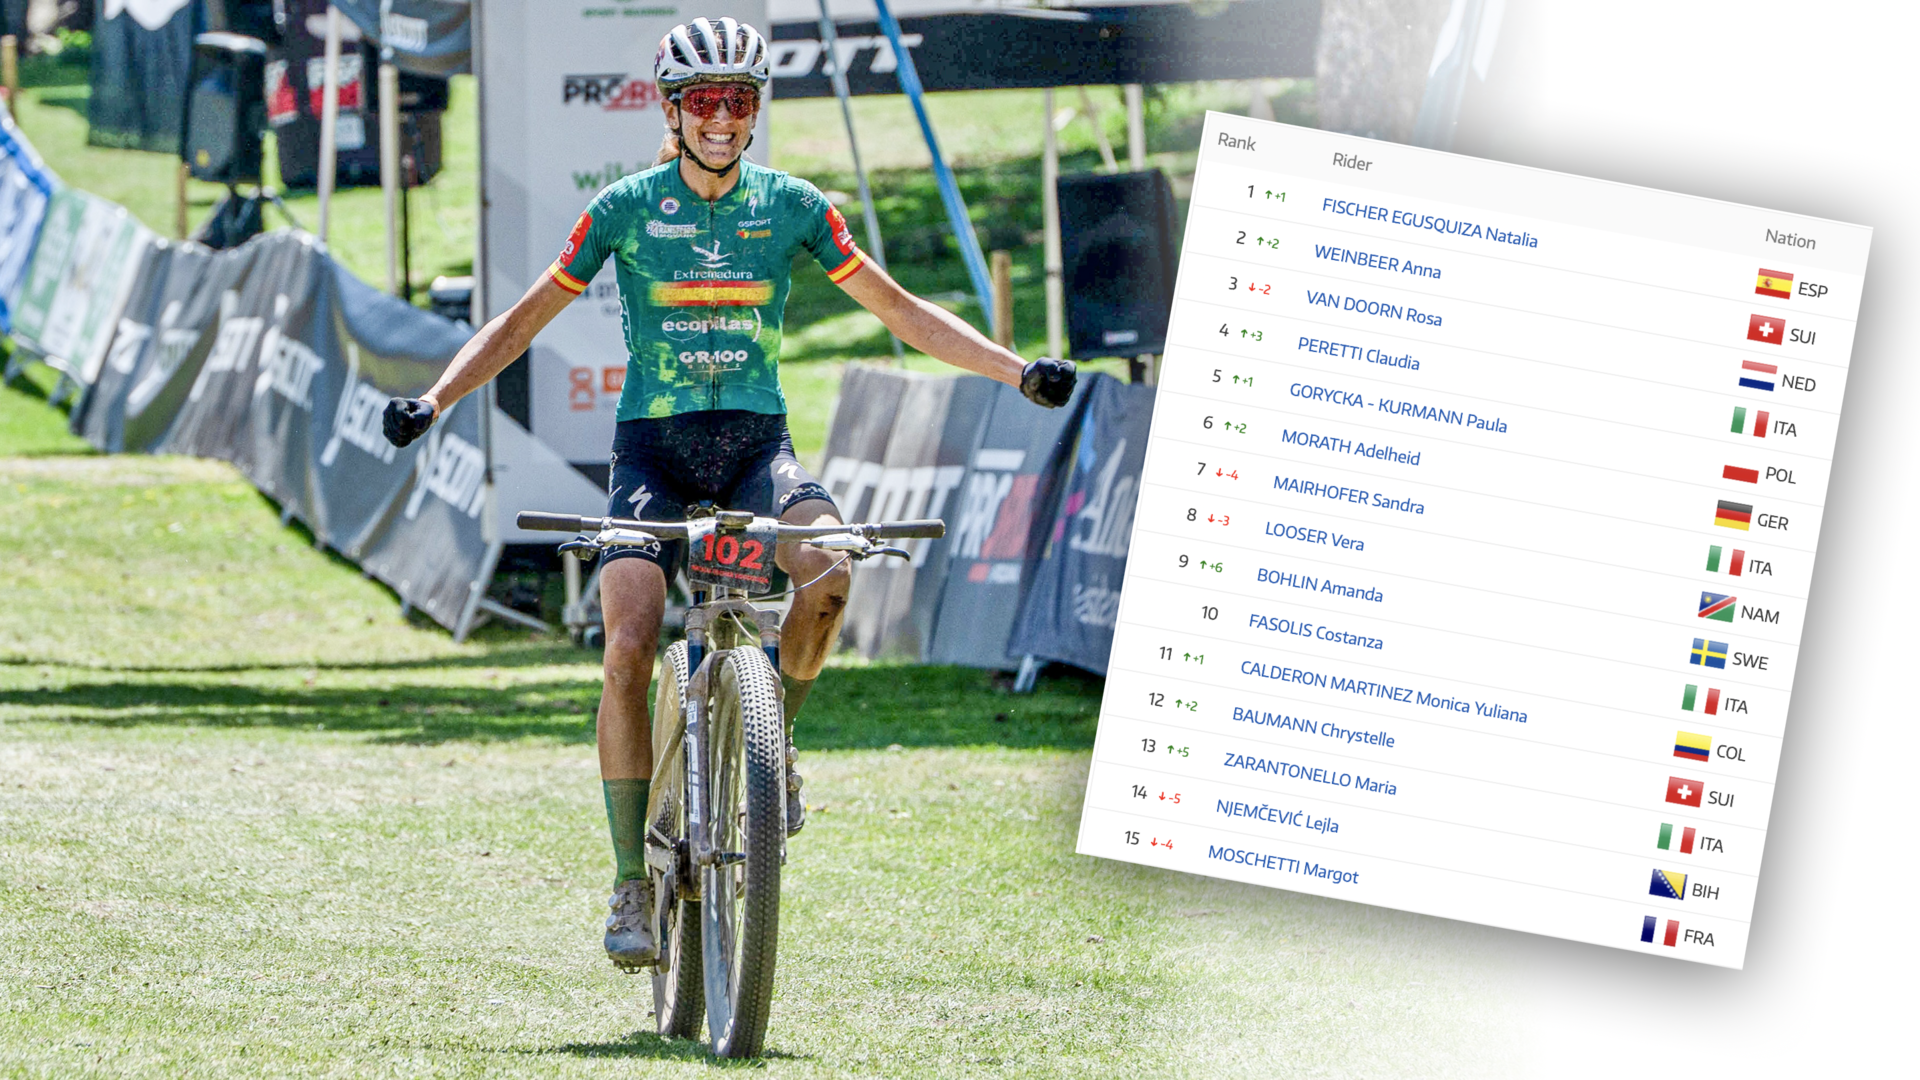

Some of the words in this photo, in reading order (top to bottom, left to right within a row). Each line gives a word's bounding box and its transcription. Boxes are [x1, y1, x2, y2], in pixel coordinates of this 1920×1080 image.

[770, 33, 923, 77] OTT
[737, 218, 772, 228] GSPORT
[673, 270, 753, 279] Extremadura
[662, 316, 754, 334] ecopilas
[702, 533, 764, 570] 102
